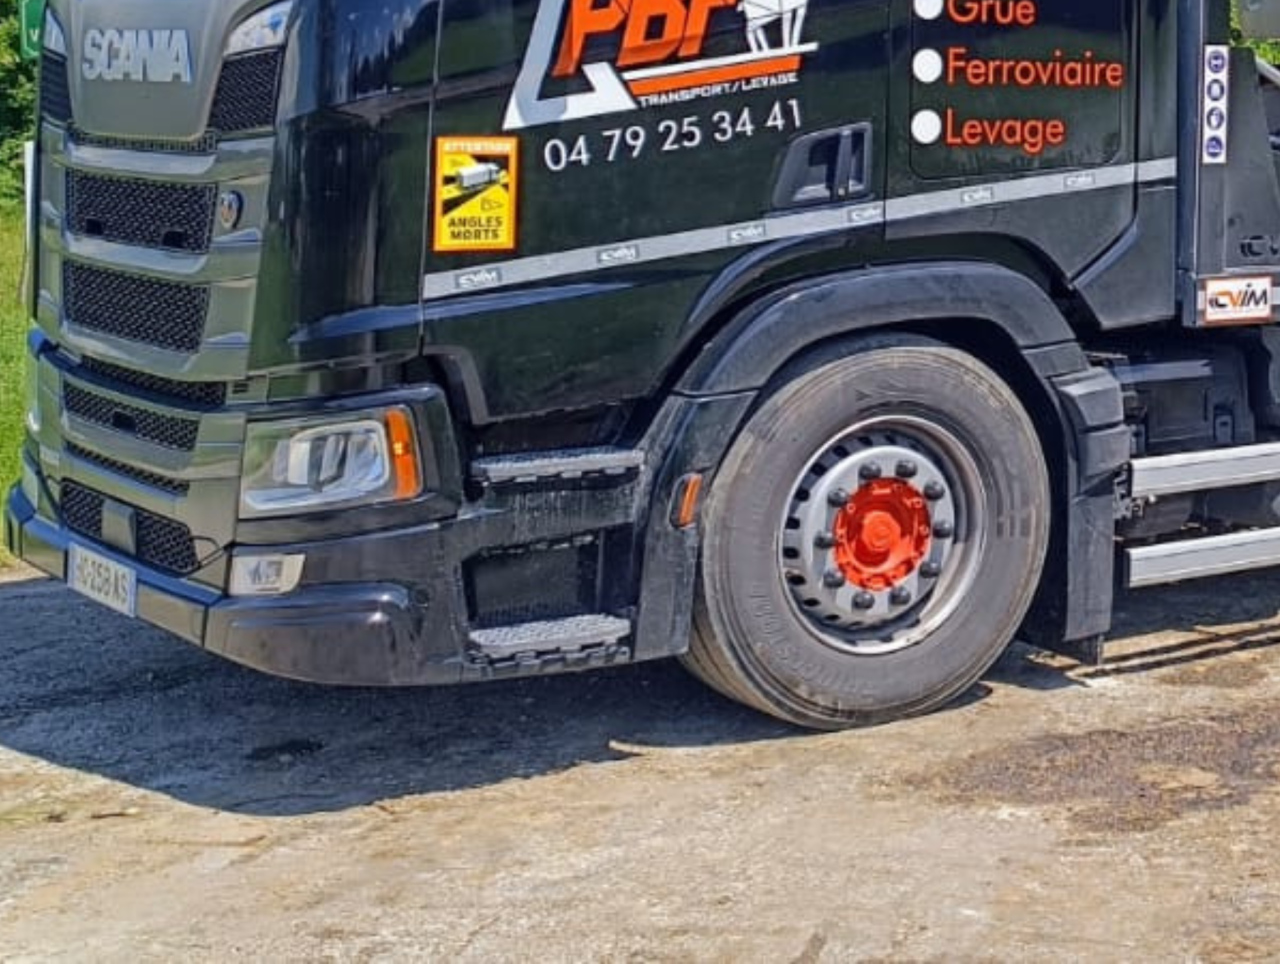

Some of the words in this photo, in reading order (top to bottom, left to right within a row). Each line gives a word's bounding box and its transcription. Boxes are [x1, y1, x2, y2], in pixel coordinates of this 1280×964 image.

[81, 28, 192, 83] SCANIA
[947, 47, 1125, 86] Ferroviaire
[543, 135, 592, 171] 04
[602, 125, 646, 162] 79
[658, 116, 702, 152] 25
[713, 107, 755, 143] 34
[766, 98, 801, 132] 41
[946, 107, 1065, 154] Levage
[447, 216, 503, 229] ANGLES
[449, 229, 500, 241] MORTS
